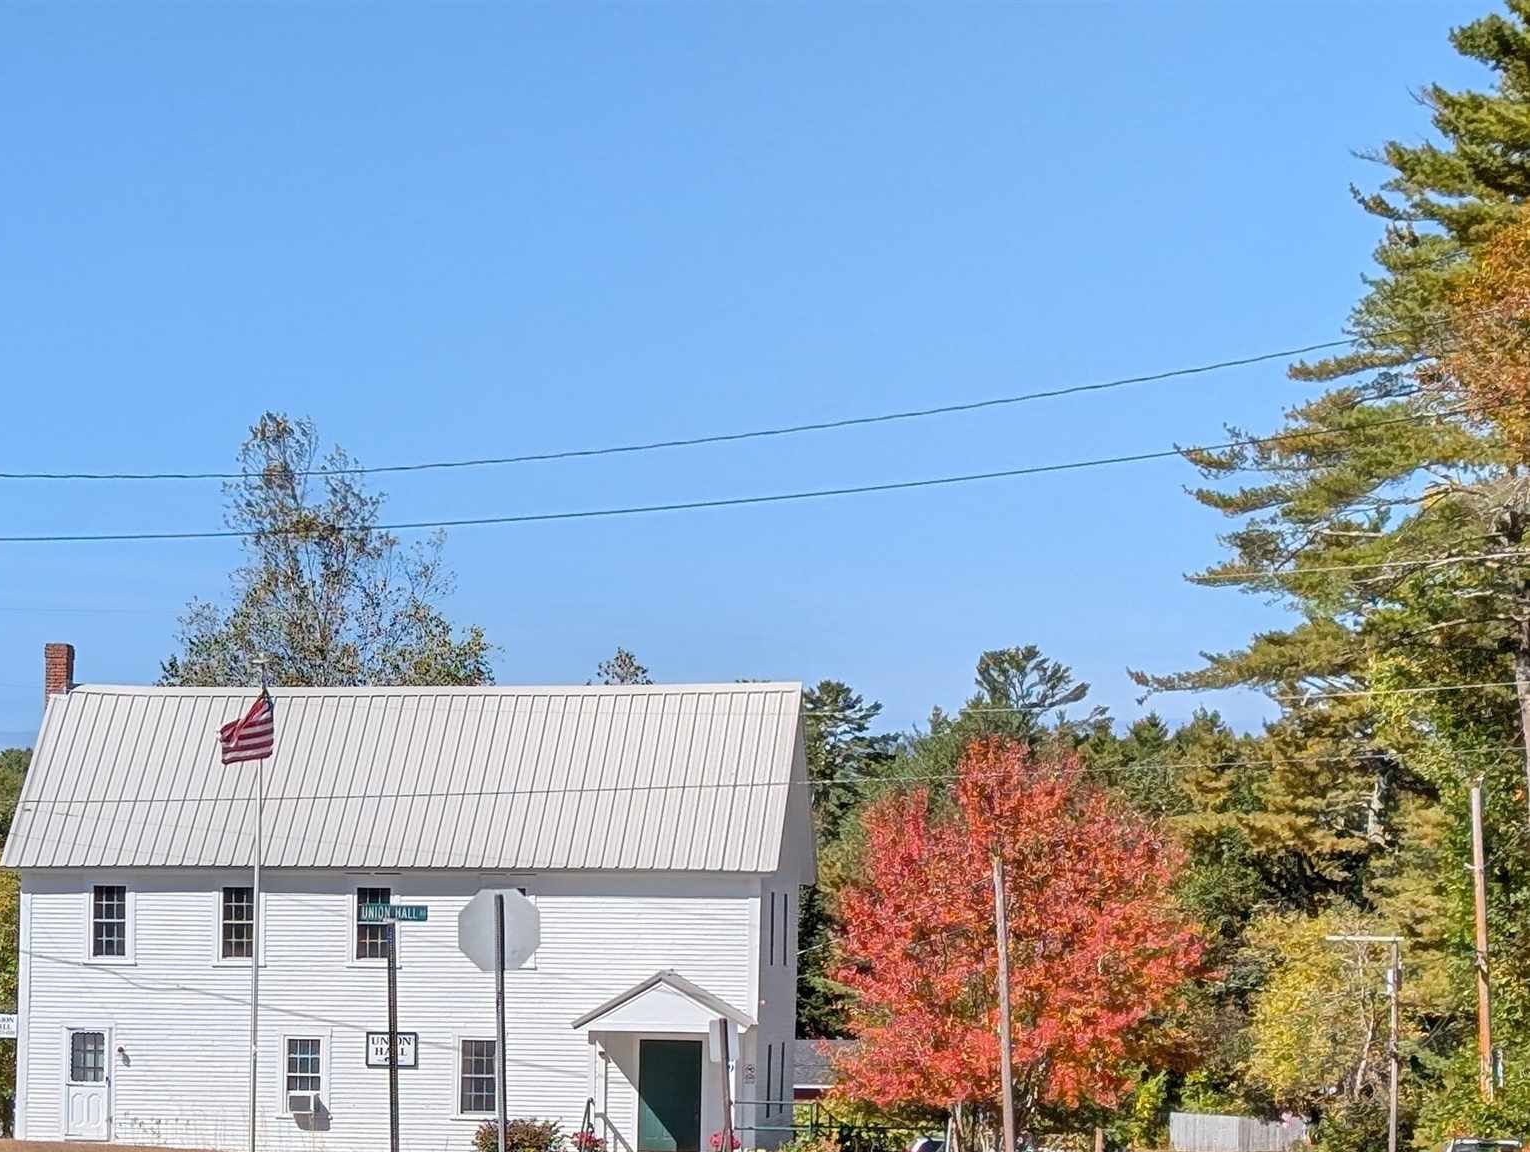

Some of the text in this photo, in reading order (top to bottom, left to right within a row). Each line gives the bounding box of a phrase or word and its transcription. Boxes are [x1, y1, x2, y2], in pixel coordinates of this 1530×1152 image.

[362, 905, 390, 919] UNION
[395, 906, 417, 919] HALL
[371, 1036, 412, 1046] UNON
[375, 1047, 408, 1056] HAL
